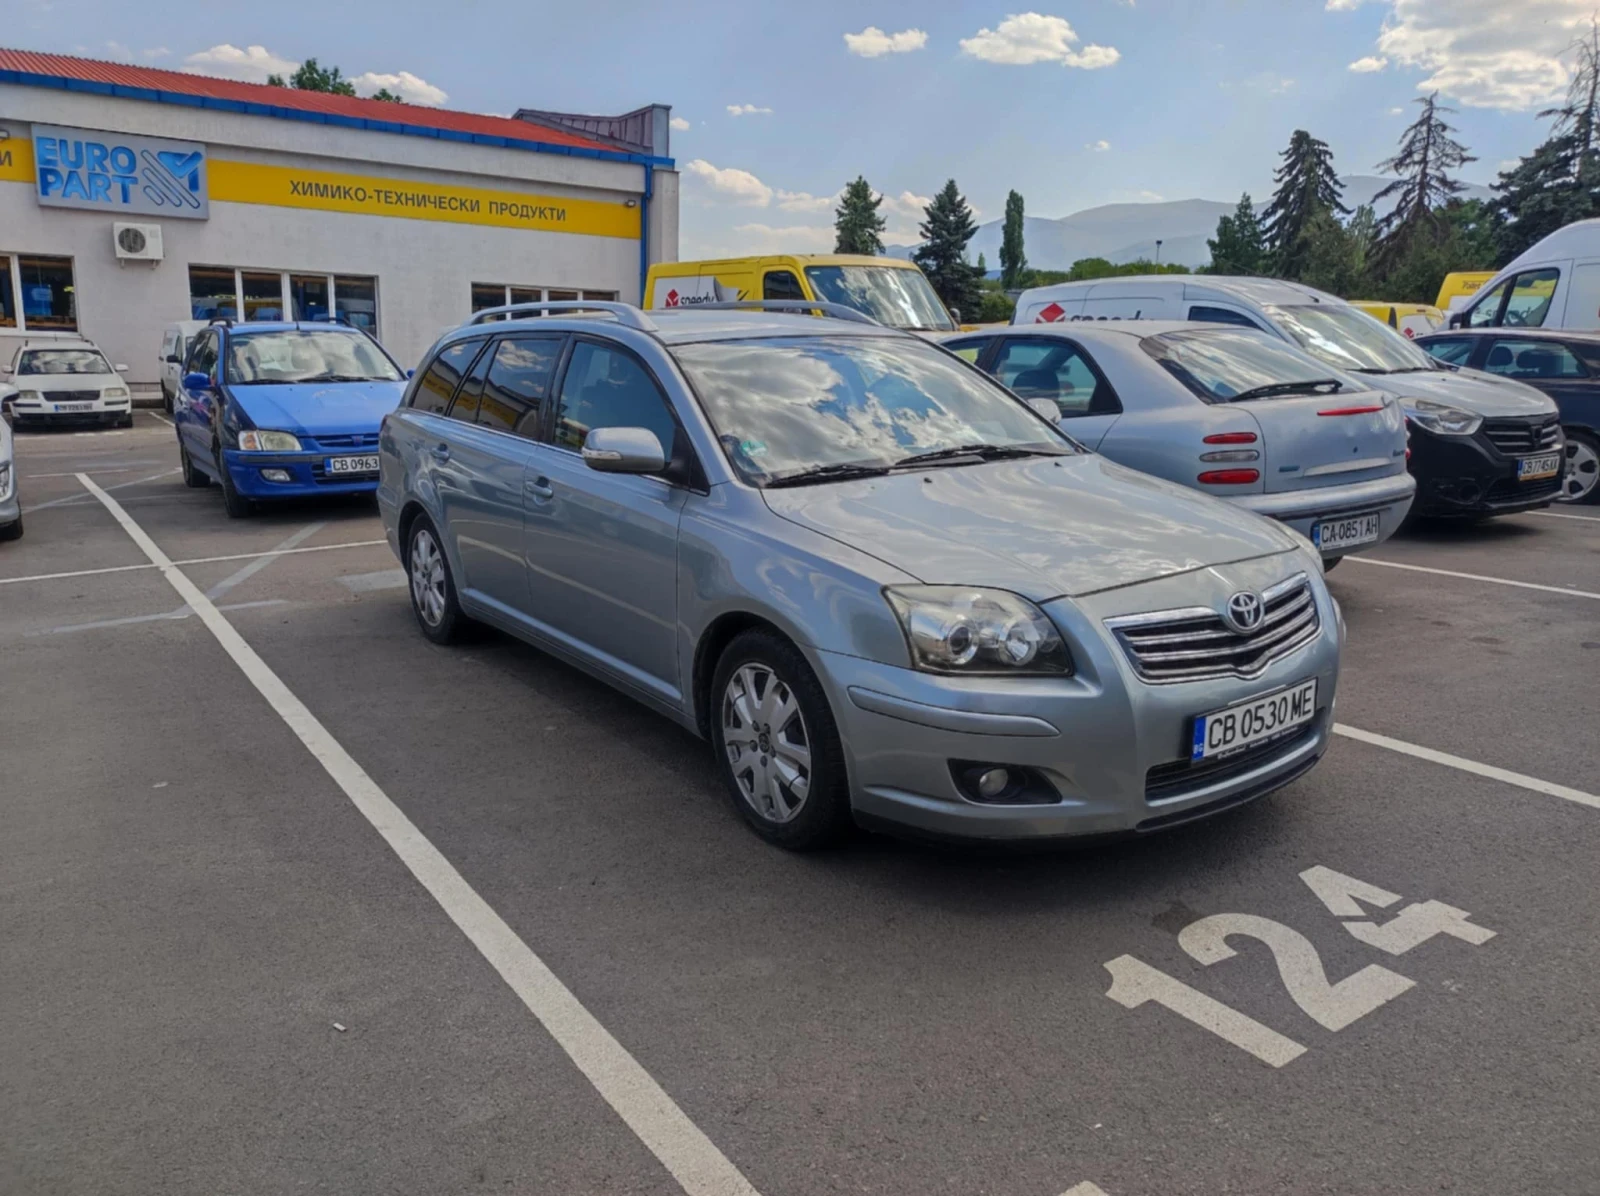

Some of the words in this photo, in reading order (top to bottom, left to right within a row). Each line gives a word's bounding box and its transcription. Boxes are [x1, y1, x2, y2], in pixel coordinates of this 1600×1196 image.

[36, 137, 137, 174] EURO
[39, 168, 138, 204] PART
[290, 180, 480, 213] ХИМИКО-ТЕХНИЧЕСКИ
[489, 201, 566, 221] ПРОДУКТИ
[350, 458, 378, 470] 0963
[1339, 520, 1364, 539] 0851
[1209, 713, 1236, 749] CB
[1241, 696, 1288, 738] 0530
[1290, 685, 1313, 721] ME
[1103, 864, 1498, 1068] 124
